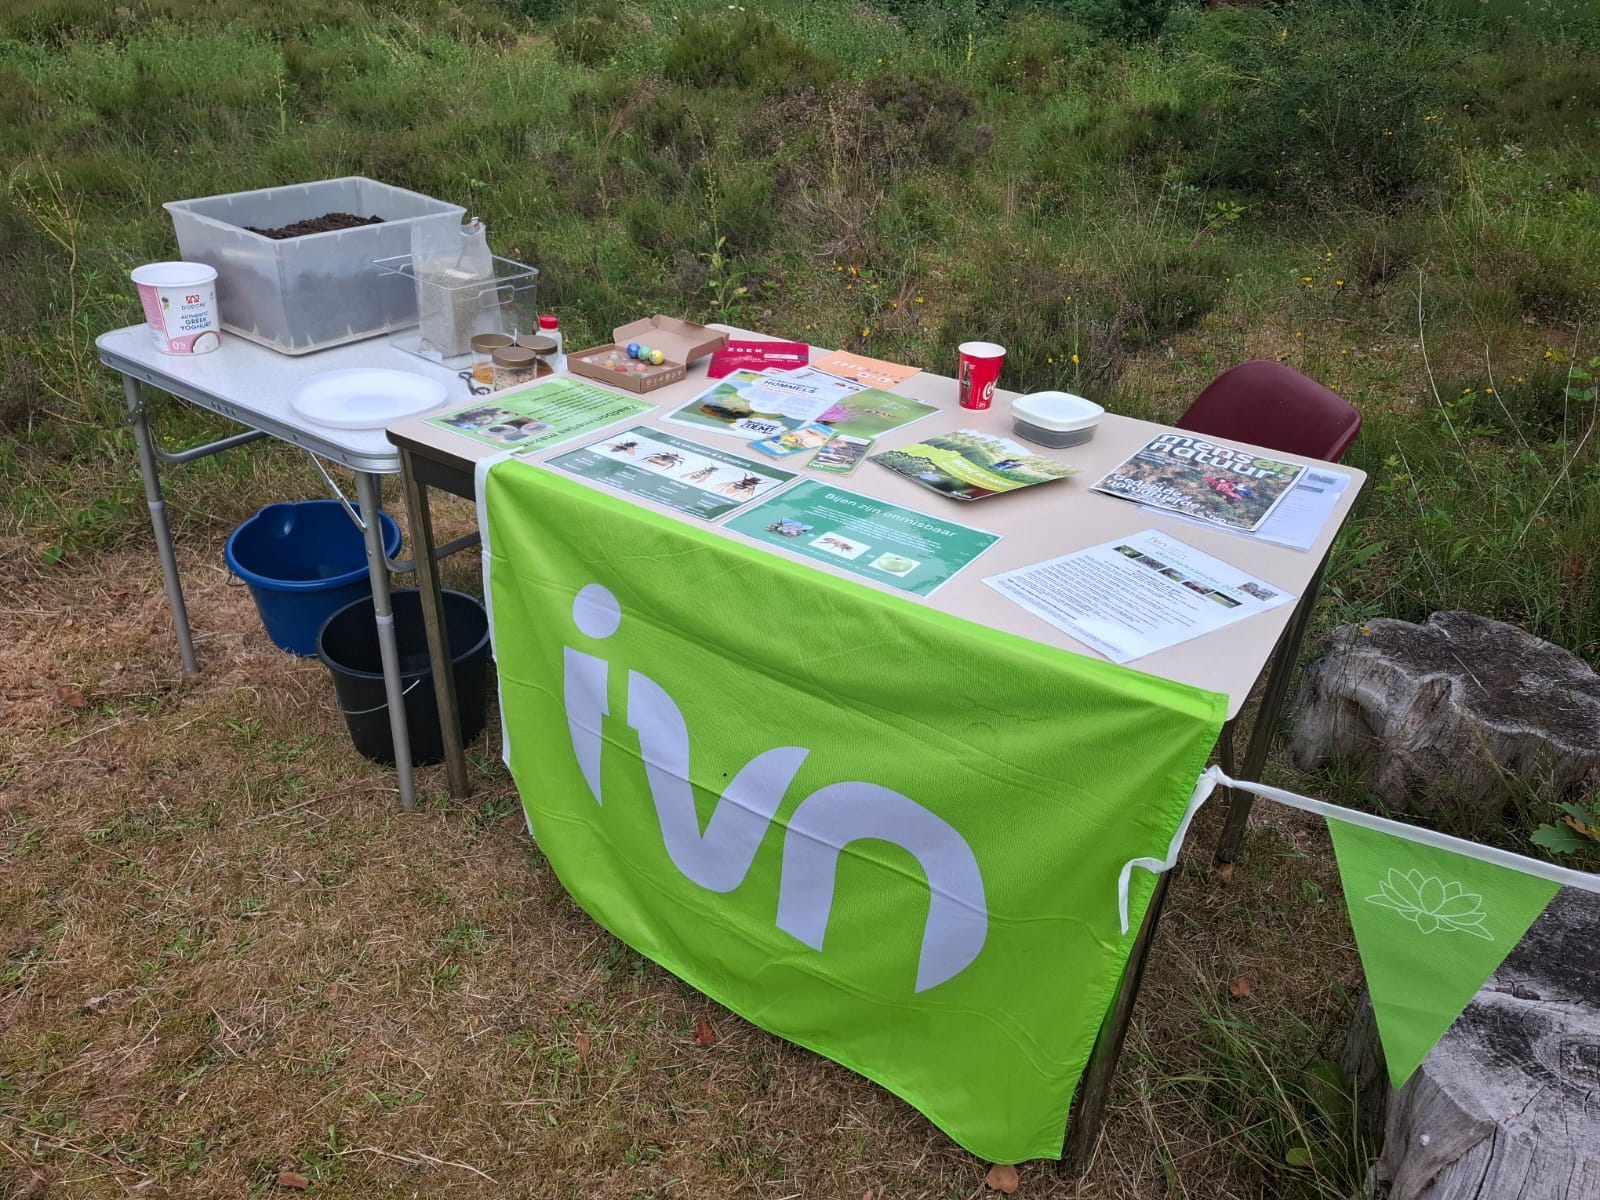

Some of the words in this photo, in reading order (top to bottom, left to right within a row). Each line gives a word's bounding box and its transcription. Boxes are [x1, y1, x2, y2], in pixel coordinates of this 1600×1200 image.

[180, 321, 212, 331] YOGHURT
[185, 317, 208, 326] GREEK
[764, 380, 816, 394] HOMMELS
[1149, 442, 1276, 479] natuur
[824, 492, 857, 508] Bijen
[858, 502, 882, 516] zijn
[883, 512, 958, 539] onmisbaar
[563, 583, 989, 994] ivn
